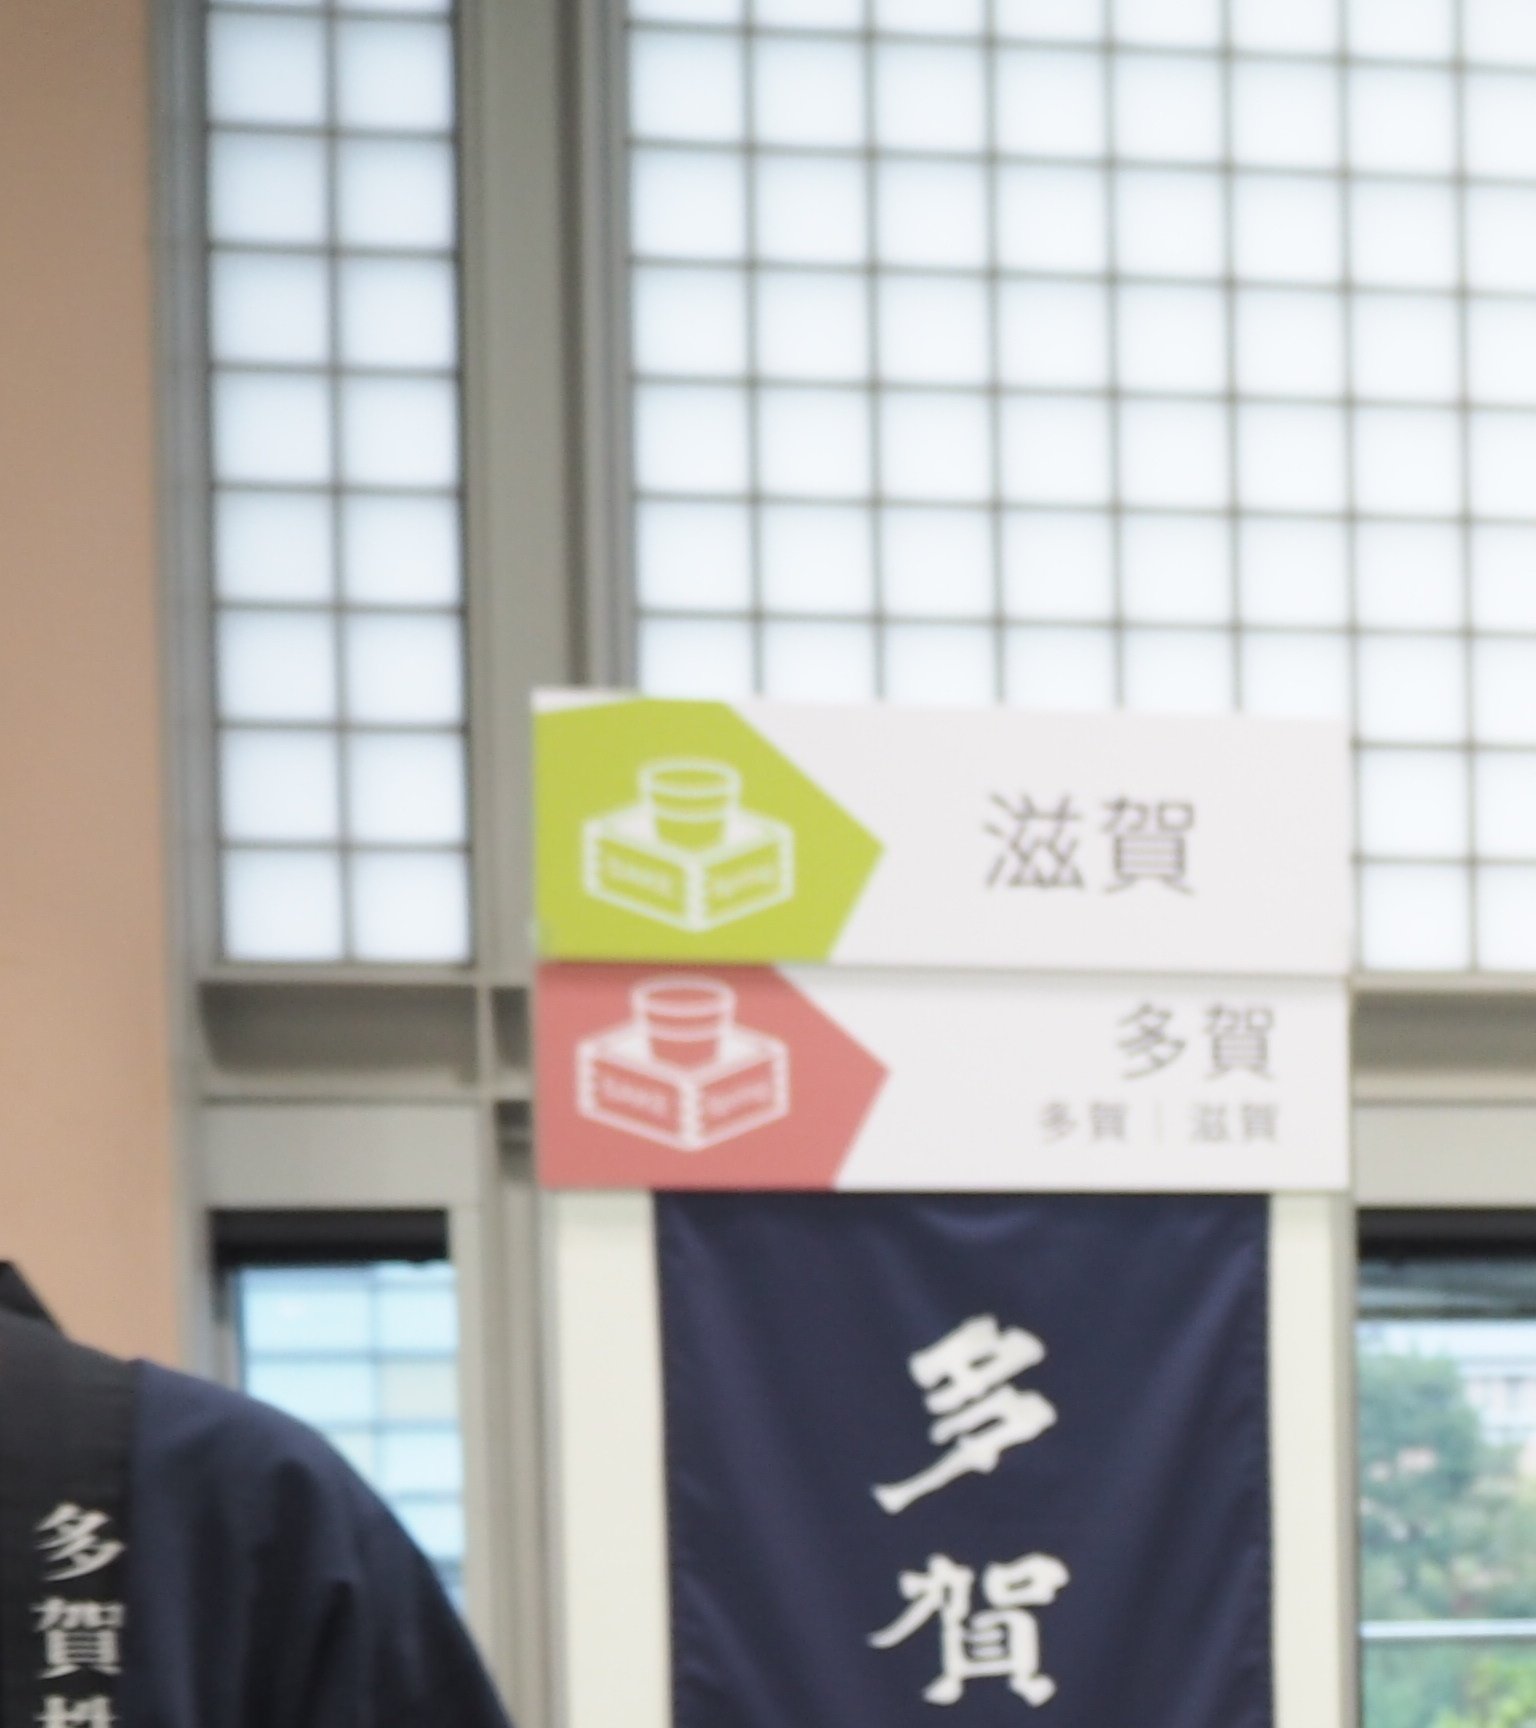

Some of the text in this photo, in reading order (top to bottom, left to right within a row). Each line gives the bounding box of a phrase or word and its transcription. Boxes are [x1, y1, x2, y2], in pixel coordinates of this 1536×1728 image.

[982, 794, 1198, 896] 滋賀
[1116, 1003, 1276, 1080] 多賀
[868, 1313, 1069, 1707] 多賀
